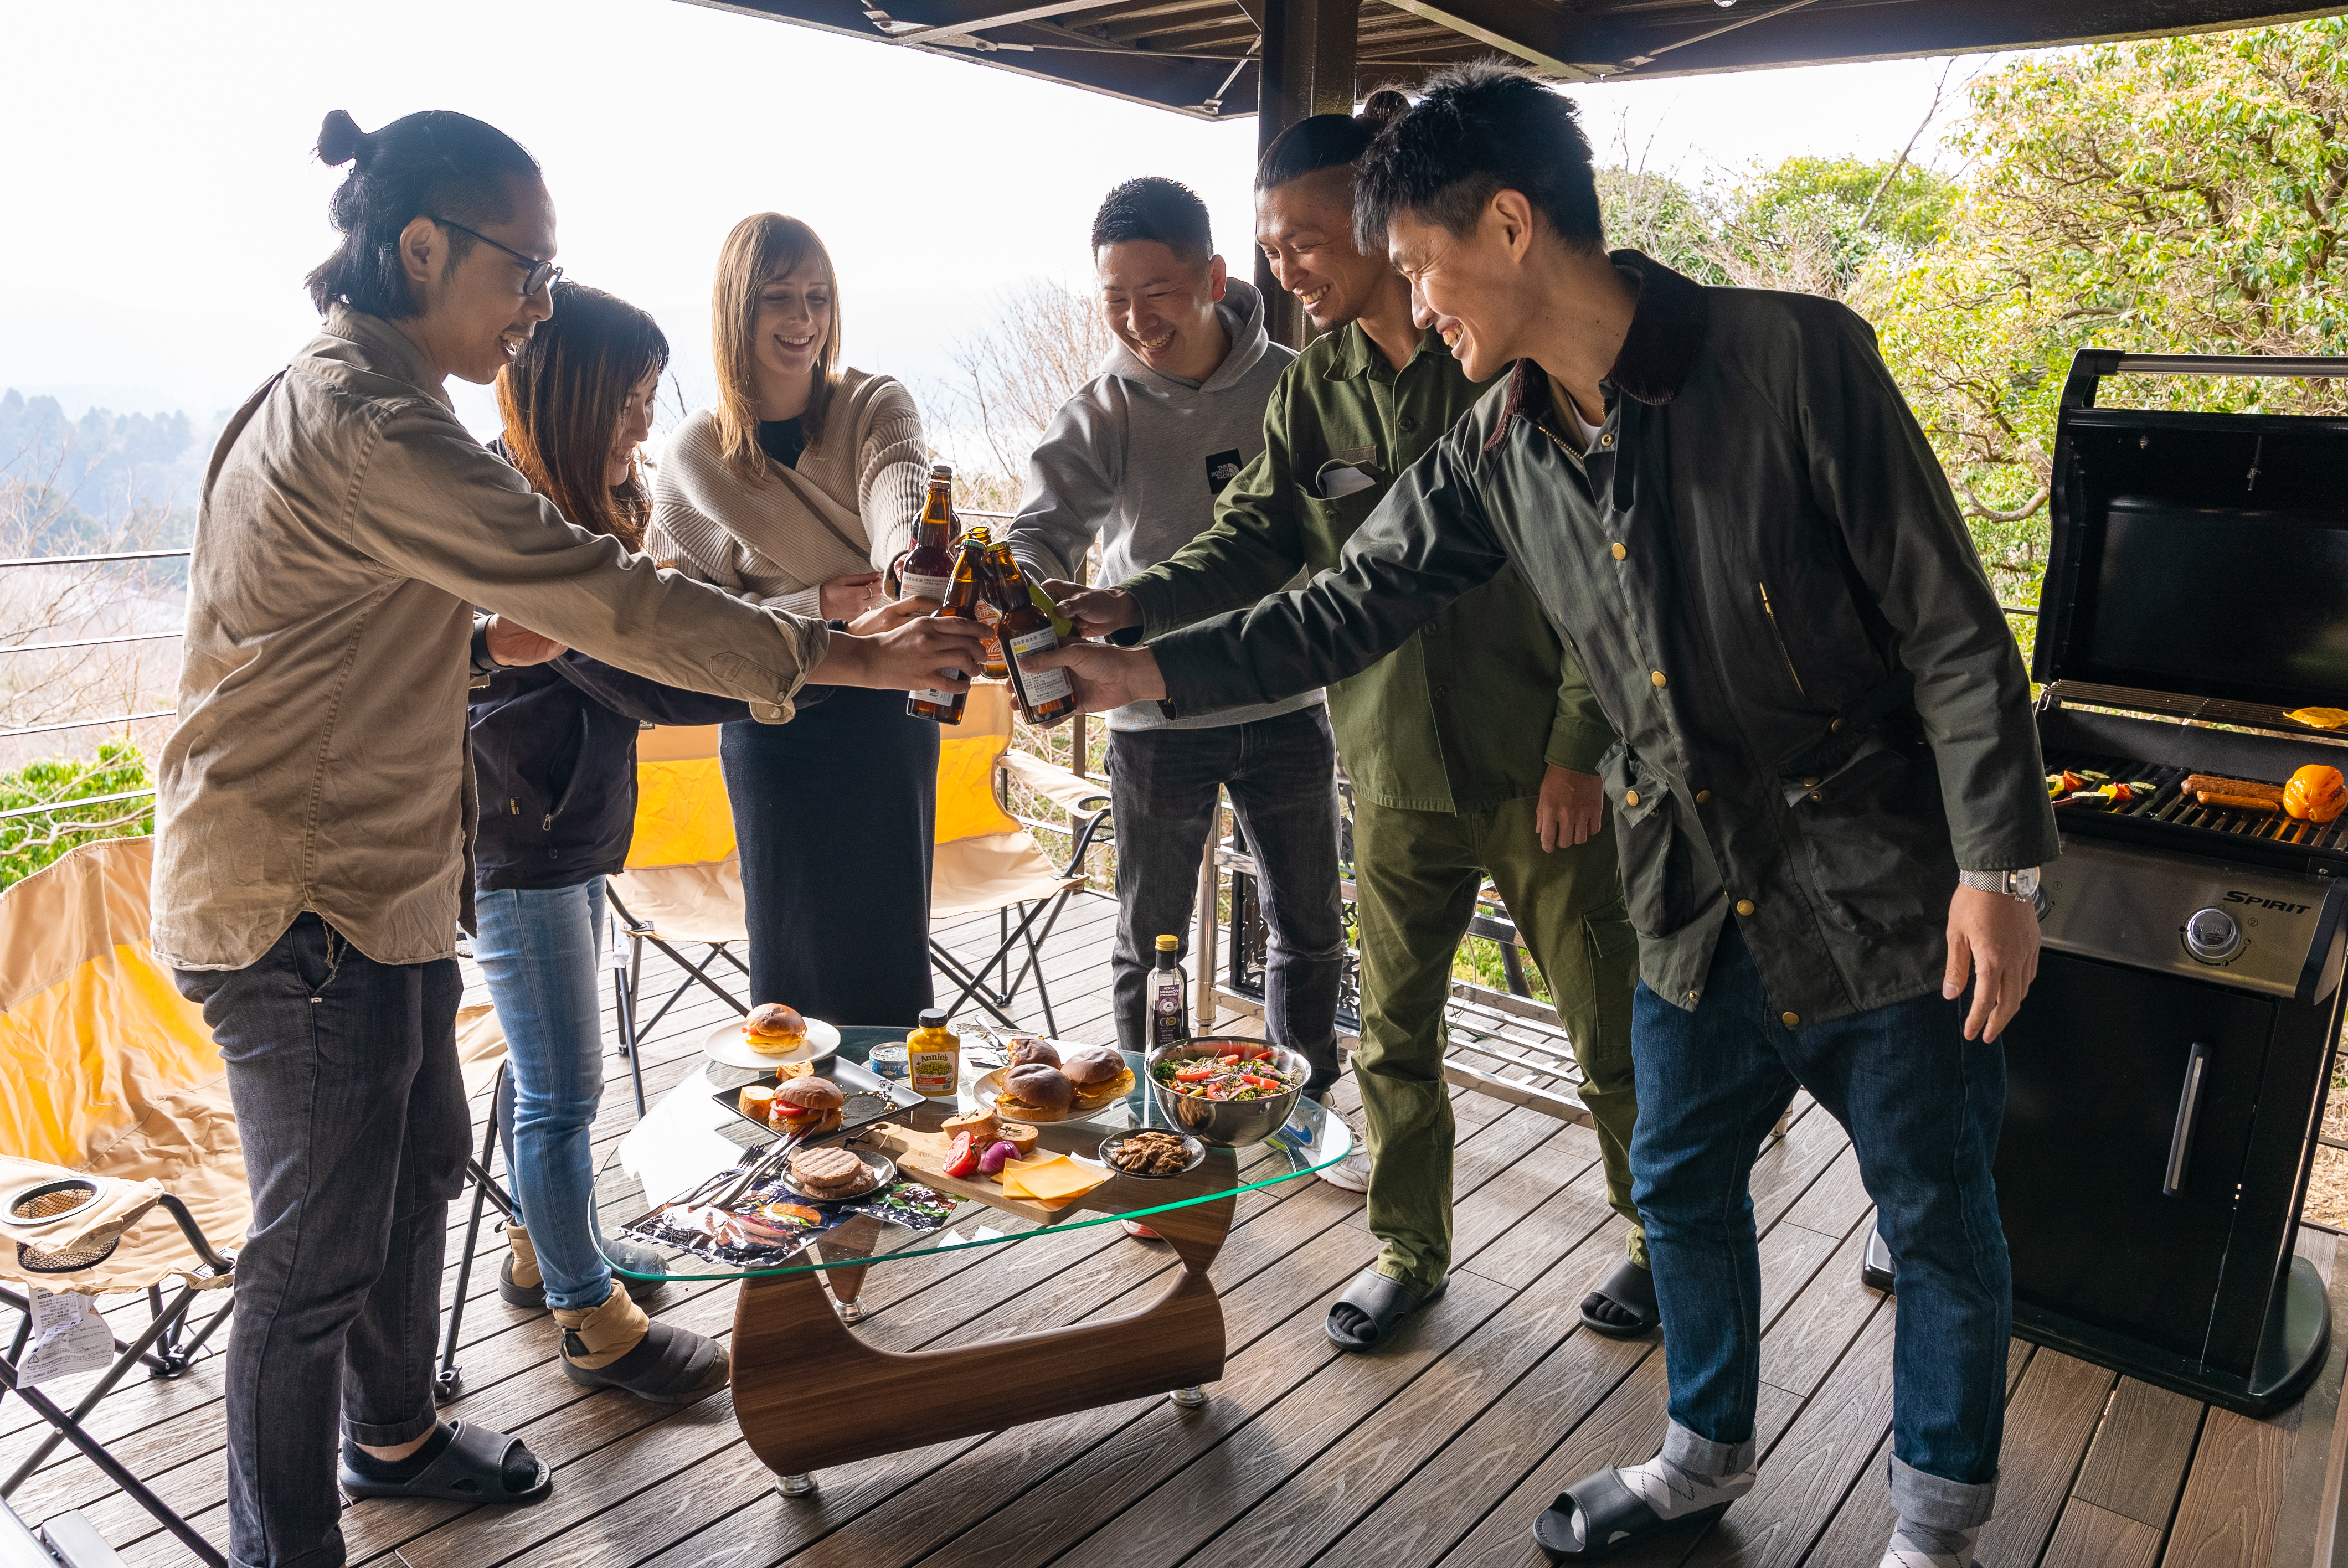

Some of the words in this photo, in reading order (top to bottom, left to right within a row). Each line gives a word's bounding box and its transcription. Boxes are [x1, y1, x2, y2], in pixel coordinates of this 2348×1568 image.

[1211, 469, 1229, 477] NORTH
[2222, 890, 2311, 915] SPIRIT
[921, 1053, 948, 1062] Annie's
